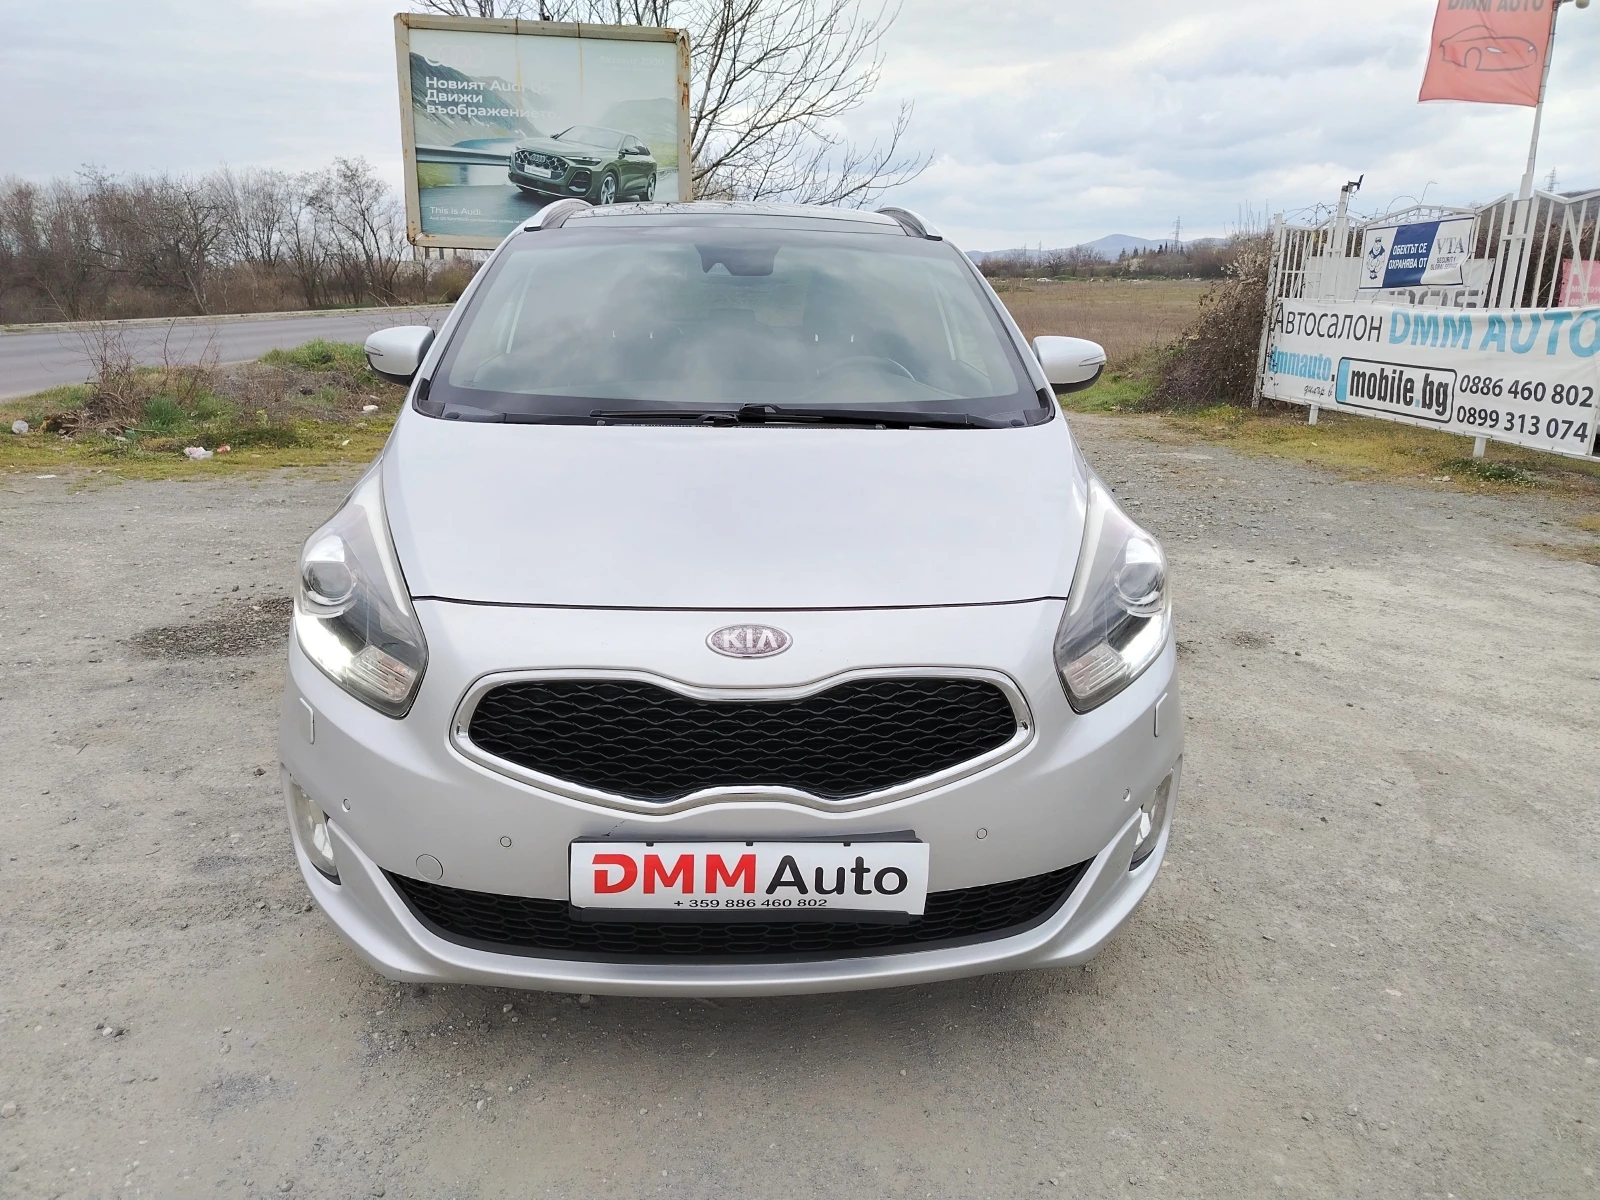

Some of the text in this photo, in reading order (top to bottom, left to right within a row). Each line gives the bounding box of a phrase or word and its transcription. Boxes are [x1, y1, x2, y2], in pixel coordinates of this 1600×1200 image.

[425, 77, 486, 91] Новият
[489, 80, 526, 92] Audi
[425, 89, 483, 103] Движи
[429, 206, 484, 216] This is Audi.
[1418, 242, 1428, 253] СЕ
[1436, 236, 1465, 255] VTA
[1418, 257, 1428, 268] ОТ
[1272, 302, 1600, 358] Автосалон DMM AUTO
[1349, 367, 1450, 416] mobile.bg
[1459, 374, 1594, 408] 0886 460 802
[1456, 405, 1589, 443] 0899 313 074
[722, 628, 778, 648] KIA
[591, 853, 909, 896] DMM Auto
[689, 898, 721, 908] 359
[724, 898, 757, 908] 886
[761, 898, 792, 908] 460
[797, 898, 828, 908] 802
